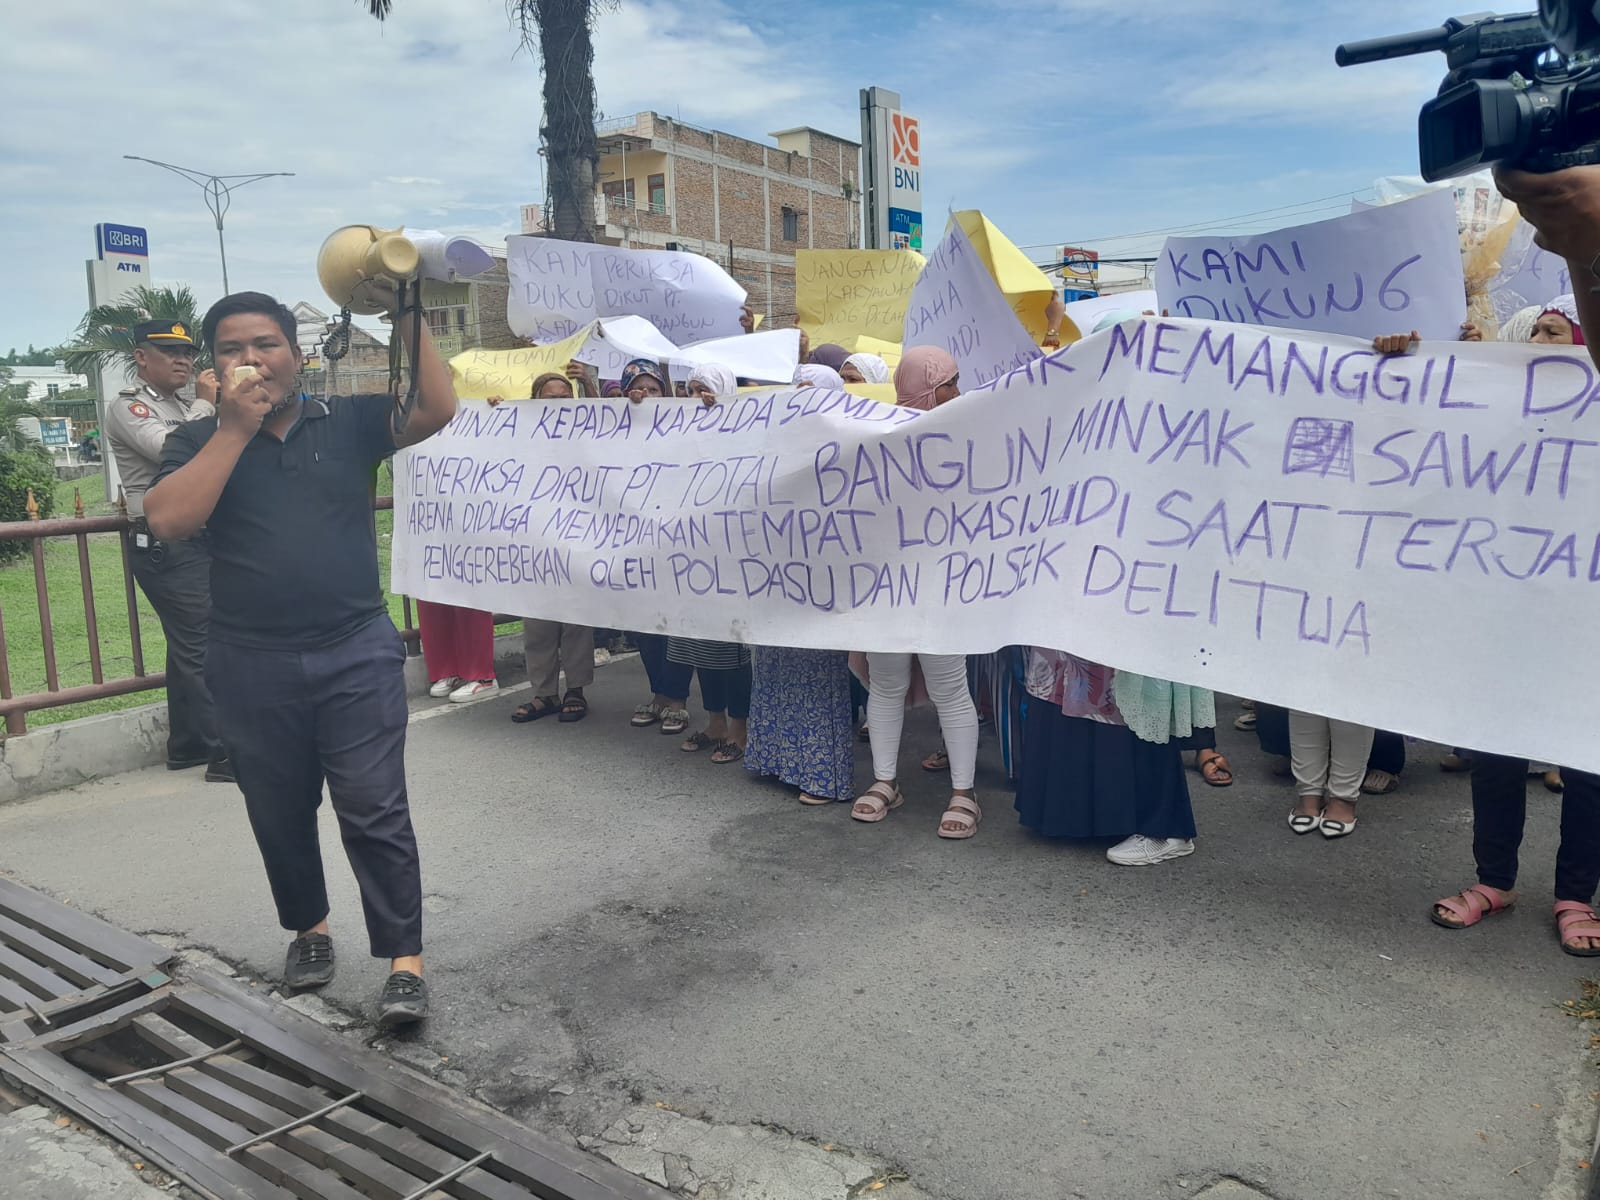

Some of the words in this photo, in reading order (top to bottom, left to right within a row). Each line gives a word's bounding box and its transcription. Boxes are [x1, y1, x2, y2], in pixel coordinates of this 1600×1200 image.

[894, 166, 920, 192] BNI
[896, 213, 910, 224] ATM
[123, 233, 144, 248] BRI
[116, 262, 141, 273] ATM
[524, 245, 592, 277] KAM
[801, 253, 901, 283] JANGAN
[1168, 240, 1306, 287] KAMI
[523, 281, 595, 311] DUKU
[530, 402, 633, 441] KEPADA
[645, 393, 776, 441] KAPOLDA
[1098, 319, 1489, 409] MEMANGGIL
[405, 453, 526, 497] MEMERIKSA
[530, 464, 624, 508] DIRUT
[620, 462, 680, 510] PT.
[679, 455, 795, 509] TOTAL
[814, 416, 1052, 507] BANGUN
[1058, 396, 1255, 468] MINYAK
[1368, 428, 1600, 500] SAWIT
[407, 500, 454, 536] ARENA
[541, 507, 711, 550] MENYEDIAKAN
[713, 508, 877, 559] TEMPAT
[1146, 488, 1331, 565] SAAT
[423, 543, 573, 587] PENGGEREBEKAN
[590, 555, 656, 591] OLEH
[850, 561, 920, 609] DAN
[937, 538, 1066, 606] POLSEK
